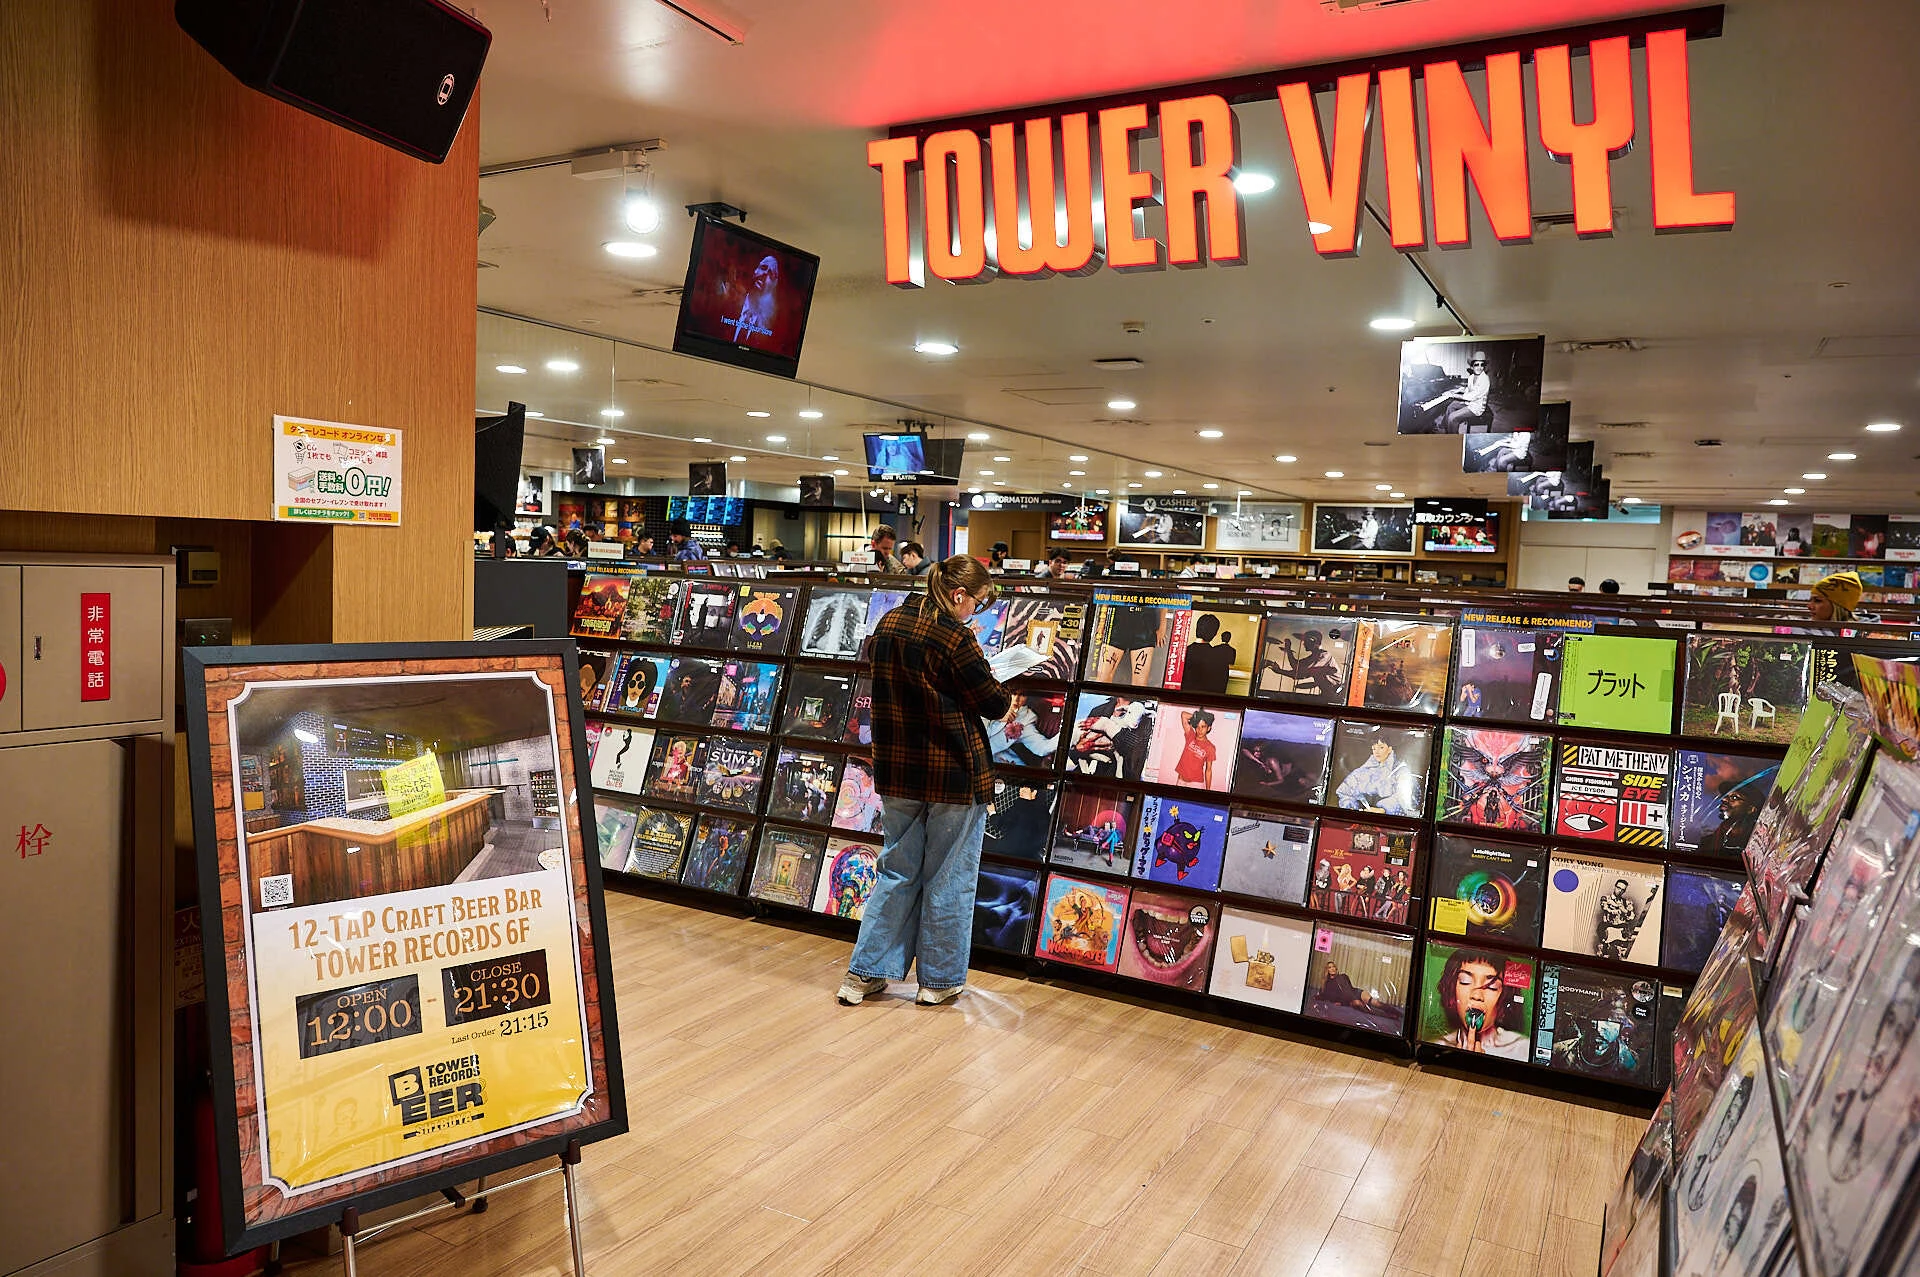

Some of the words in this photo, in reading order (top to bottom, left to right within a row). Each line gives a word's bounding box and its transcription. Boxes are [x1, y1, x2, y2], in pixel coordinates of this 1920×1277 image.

[867, 93, 1243, 288] TOWER
[1278, 28, 1738, 257] VINYL
[985, 496, 1040, 504] INFORMATION
[1160, 498, 1198, 507] CASHIER
[1112, 595, 1138, 603] RELEASE
[1145, 597, 1191, 606] RECOMMENDS
[1463, 613, 1485, 623] NEW
[1485, 615, 1521, 625] RELEASE
[1523, 617, 1530, 625] &
[1531, 617, 1593, 629] RECOMMENDS
[87, 605, 104, 688] 非常電話
[1588, 669, 1646, 699] ブラット
[710, 751, 746, 764] SUM
[746, 756, 761, 767] 41
[1580, 747, 1602, 765] PAT
[1604, 750, 1667, 772] METHENY
[1585, 778, 1613, 786] FISHMAN
[1622, 774, 1668, 789] SIDE-
[1679, 765, 1693, 801] シャバカ
[1622, 787, 1661, 802] EYE
[15, 823, 53, 860] 栓
[1576, 859, 1604, 868] WONG
[1581, 866, 1620, 875] MONTREUX
[288, 911, 376, 949] 12-TAP
[381, 904, 445, 933] CRAFT
[452, 895, 500, 922] BEER
[504, 888, 542, 914] BAR
[315, 941, 398, 981] TOWER
[404, 922, 502, 964] RECORDS
[506, 917, 530, 945] 6F
[470, 961, 522, 982] CLOSE
[337, 988, 388, 1010] OPEN
[453, 972, 541, 1015] 21:30
[307, 1000, 412, 1048] 12:00
[451, 1034, 469, 1044] Last
[471, 1027, 496, 1040] Order
[499, 1010, 549, 1038] 21:15
[426, 1054, 480, 1076] TOWER
[429, 1066, 481, 1088] RECORDS
